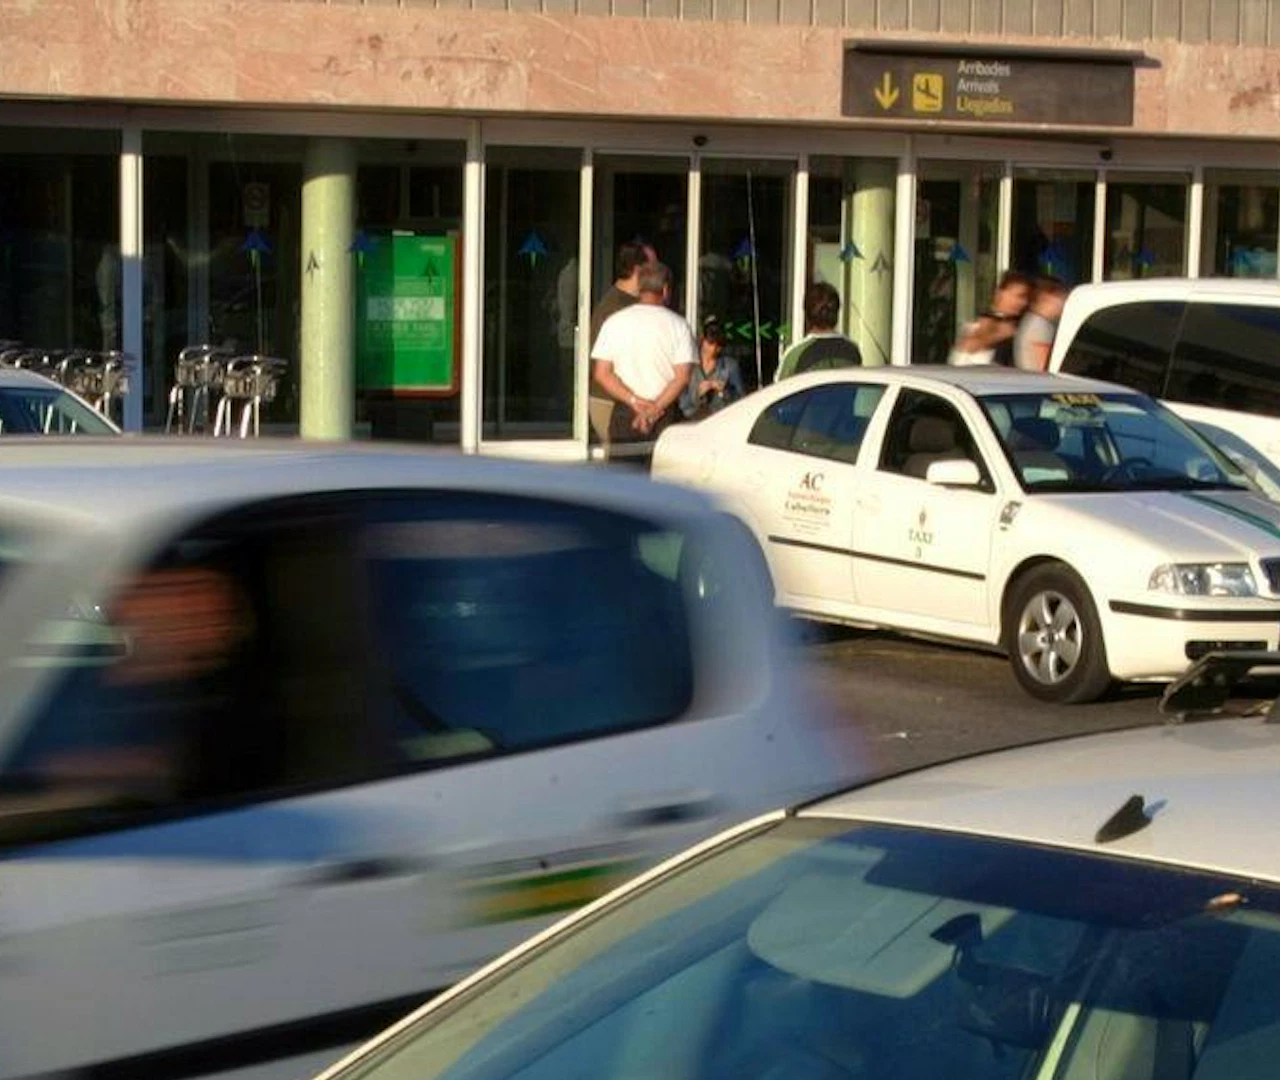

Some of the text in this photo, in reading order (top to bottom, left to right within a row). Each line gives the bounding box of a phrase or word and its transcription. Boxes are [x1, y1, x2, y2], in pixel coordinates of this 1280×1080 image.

[957, 60, 1011, 77] Arribades
[956, 78, 1000, 94] Arrivals
[956, 96, 1014, 116] Llegadas
[1051, 393, 1101, 406] TAXI
[908, 528, 933, 545] TAXI
